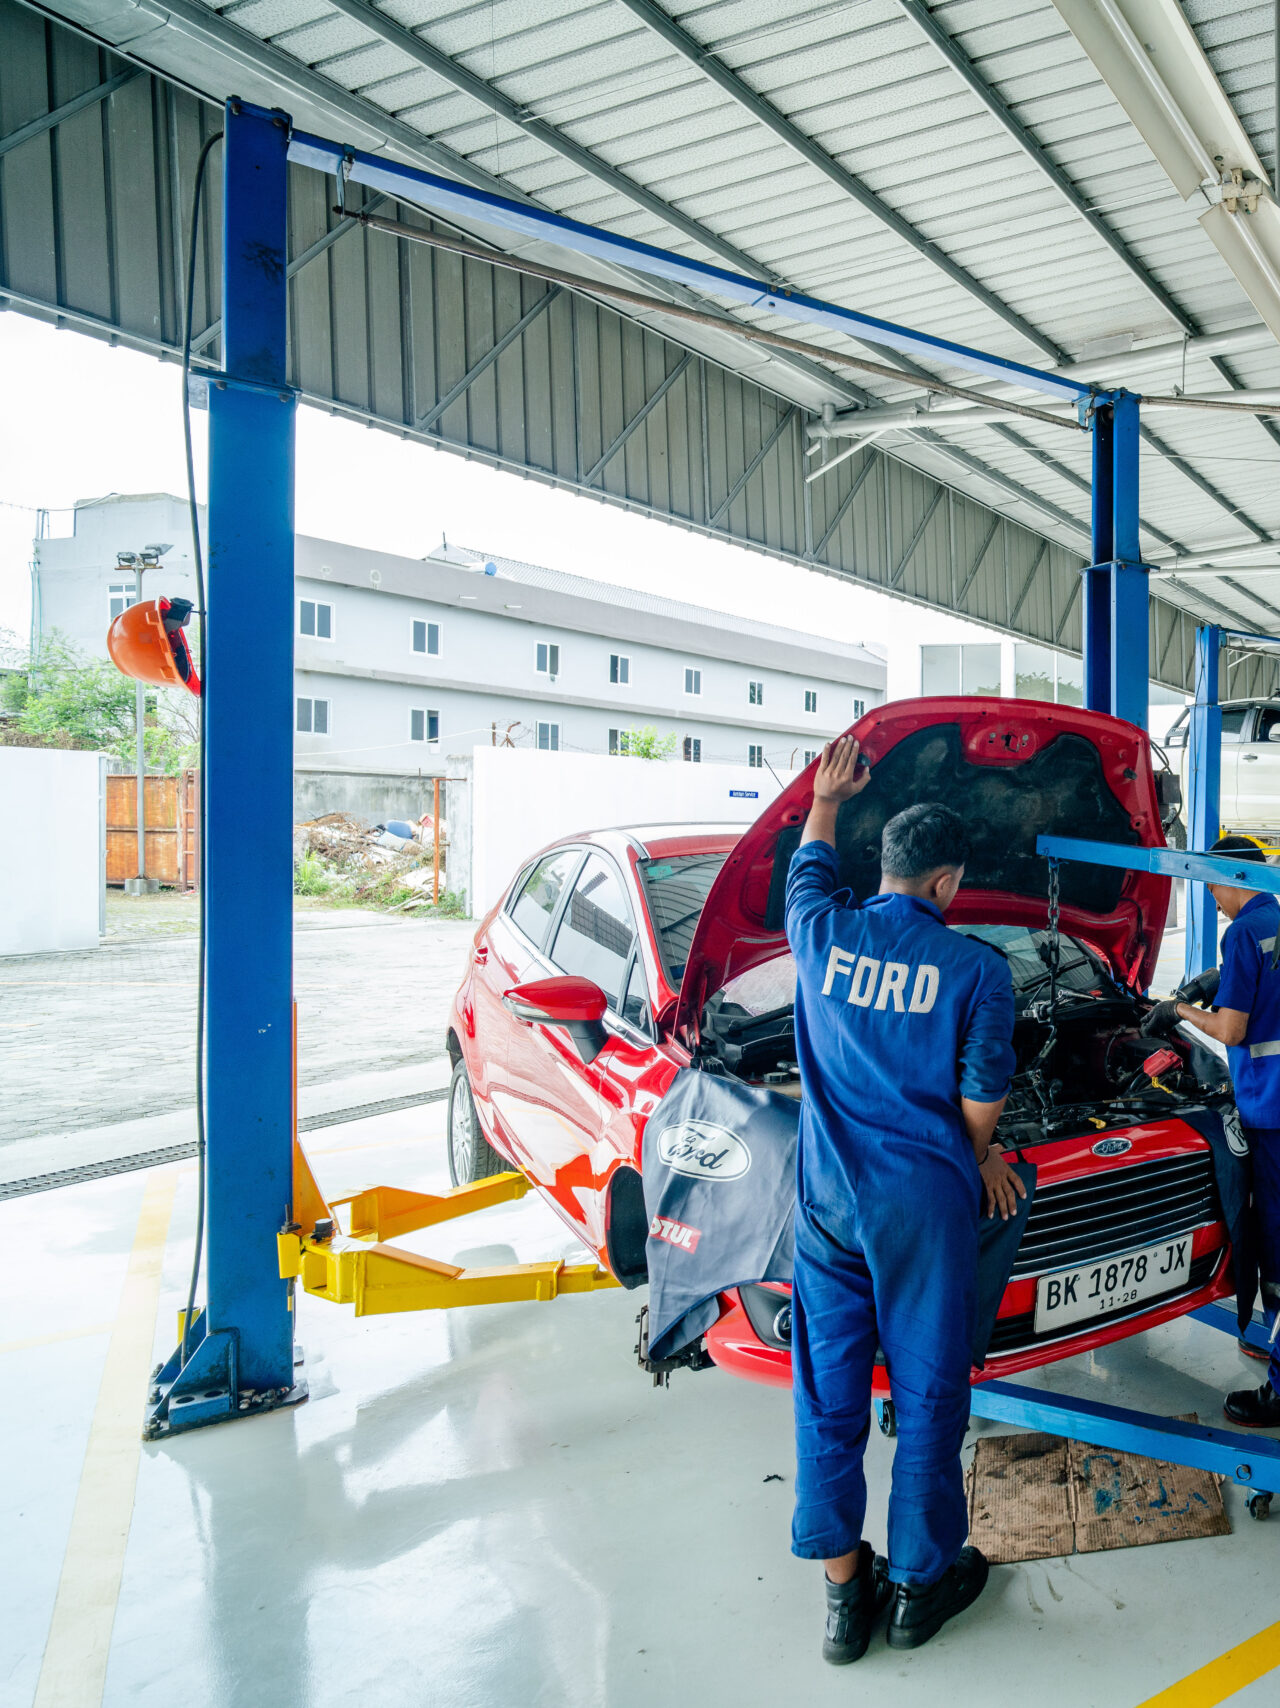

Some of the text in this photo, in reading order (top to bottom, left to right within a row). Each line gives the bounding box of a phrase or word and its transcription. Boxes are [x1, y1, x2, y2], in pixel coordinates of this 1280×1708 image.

[821, 945, 940, 1014] FORD
[667, 1126, 730, 1170] Ford
[649, 1217, 694, 1249] OTUL
[1047, 1241, 1187, 1311] BK 1878 JX
